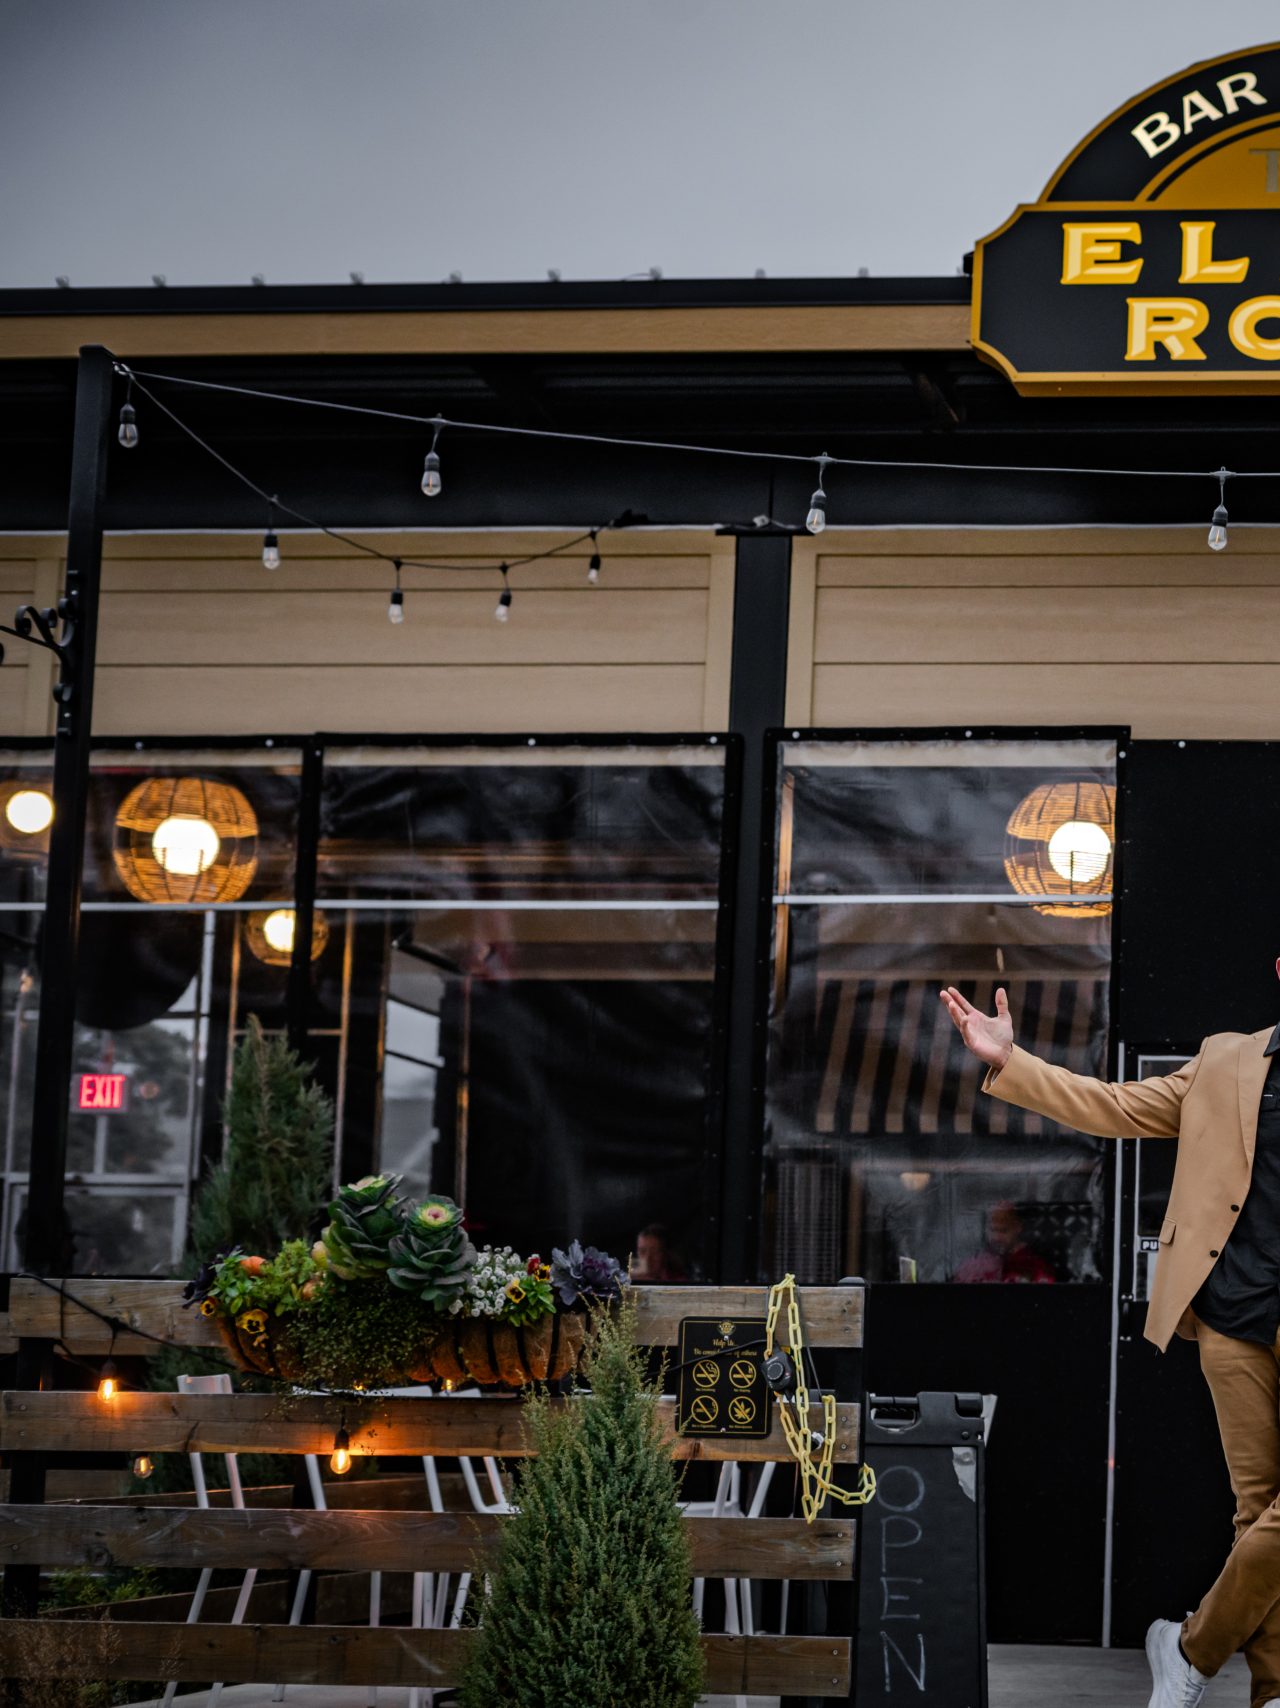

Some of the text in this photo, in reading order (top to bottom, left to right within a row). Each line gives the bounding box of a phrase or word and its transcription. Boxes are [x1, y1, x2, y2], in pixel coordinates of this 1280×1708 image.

[1131, 71, 1267, 158] BAR
[80, 1074, 126, 1109] EXIT
[1142, 1240, 1158, 1250] PU
[877, 1465, 926, 1692] OPEN
